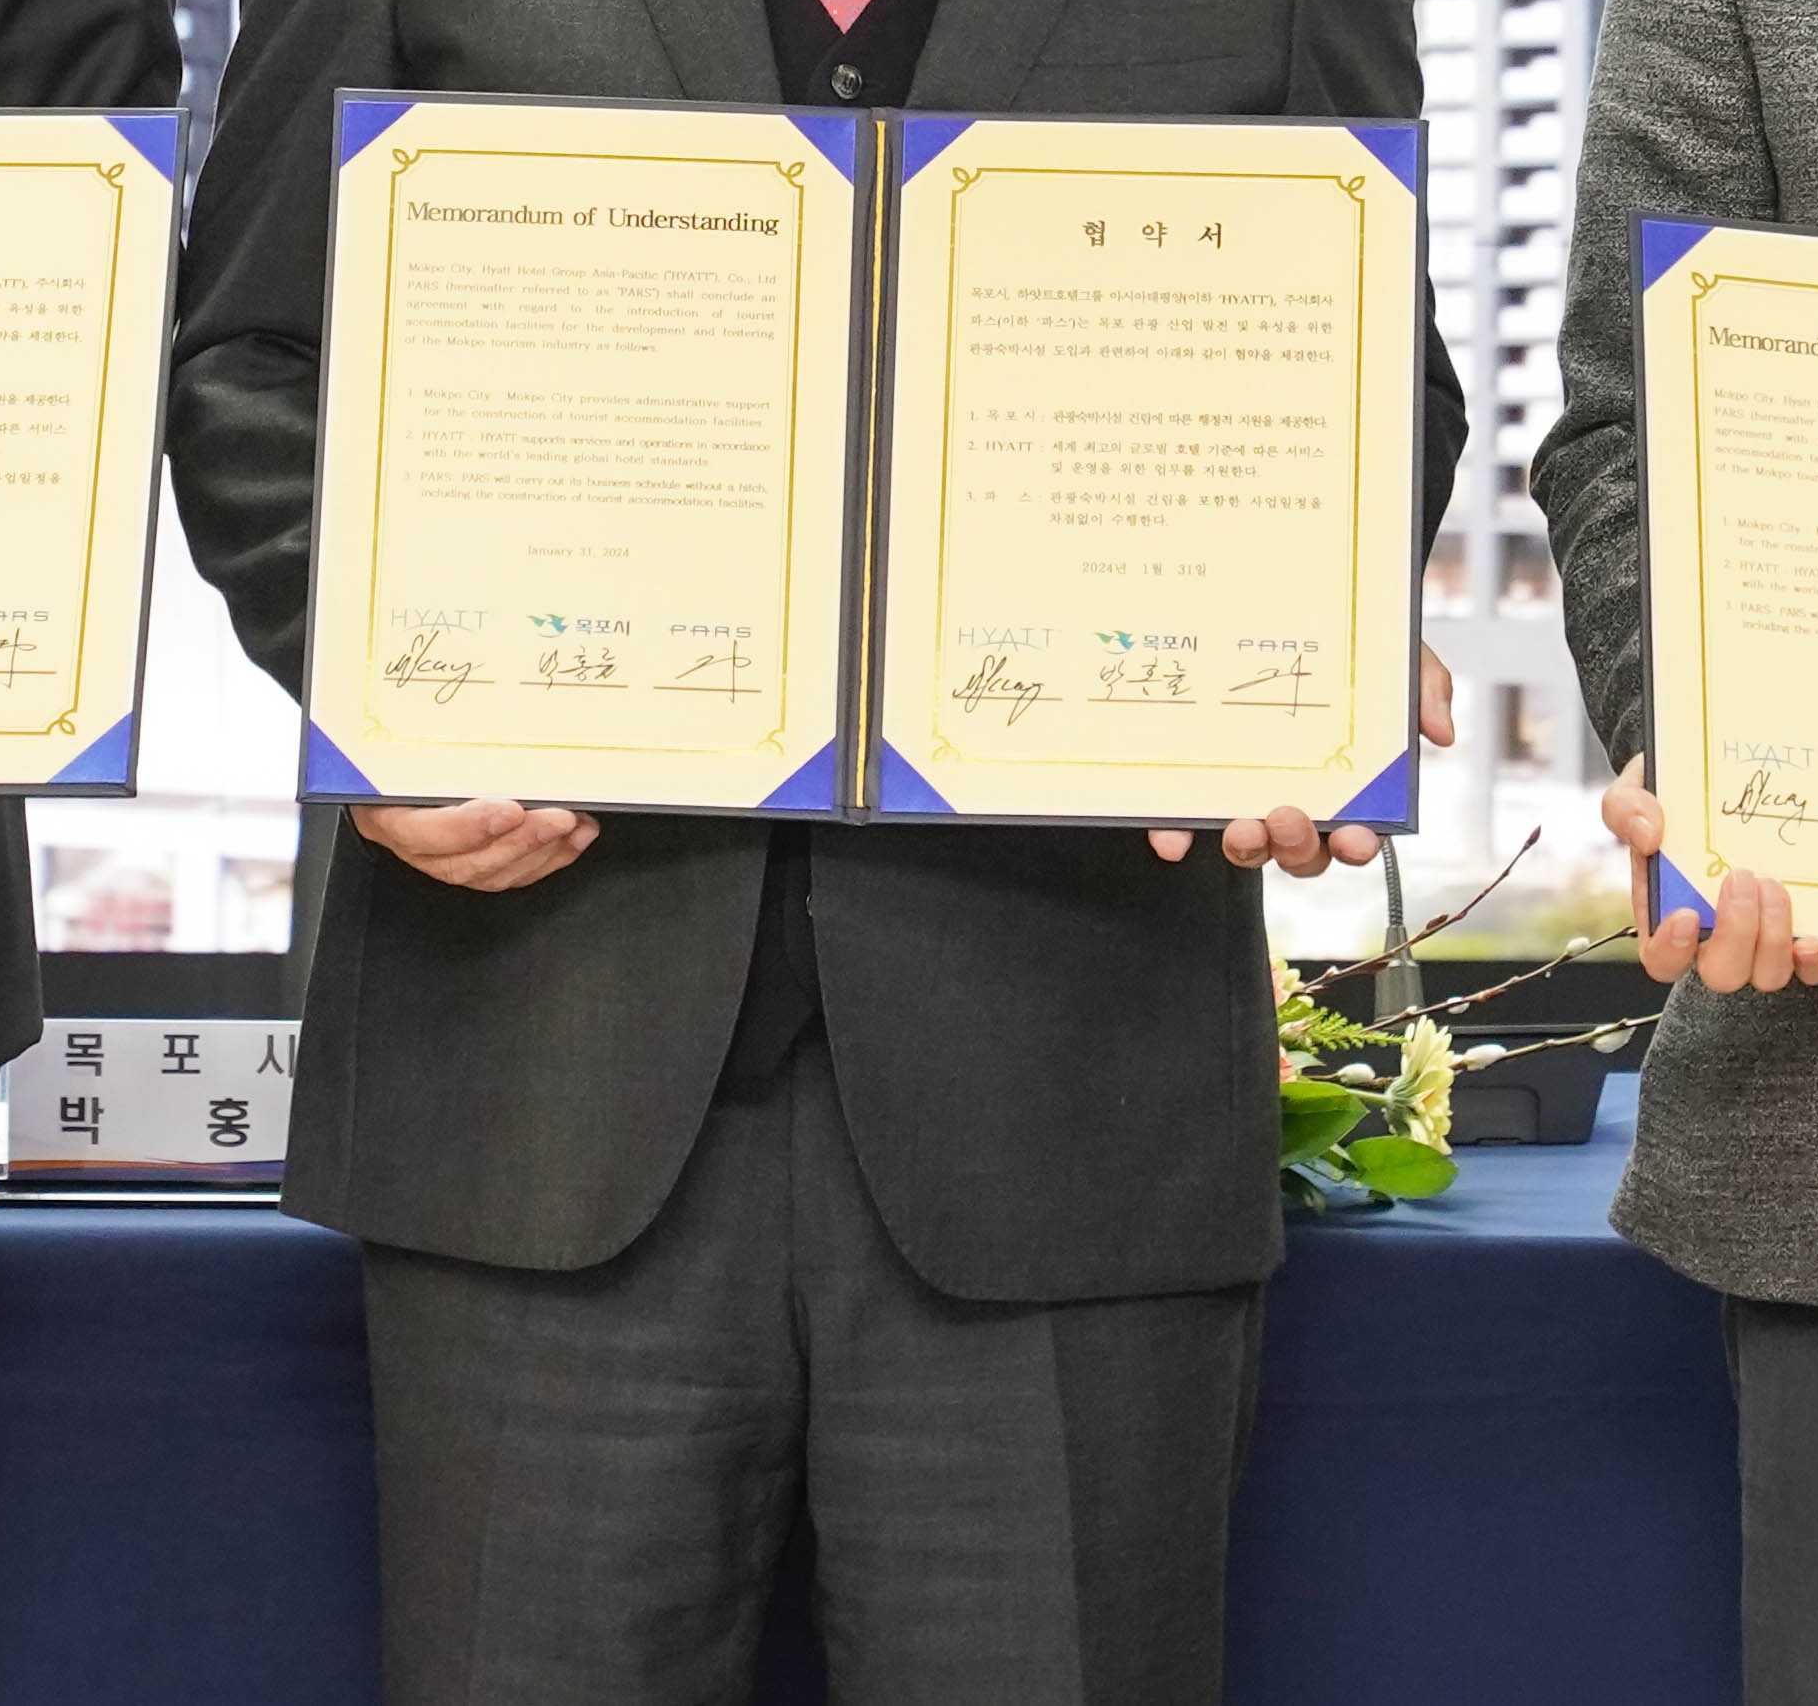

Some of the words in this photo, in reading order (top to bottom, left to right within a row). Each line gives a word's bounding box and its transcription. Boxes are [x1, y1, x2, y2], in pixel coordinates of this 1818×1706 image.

[406, 201, 564, 226] Memorandum
[572, 206, 598, 227] of
[608, 207, 781, 237] Understanding
[390, 606, 488, 634] HYATT
[575, 618, 631, 637] 목포시
[669, 624, 752, 639] PARS
[958, 625, 1055, 651] HYATT
[1142, 634, 1198, 653] 목포시
[1236, 638, 1319, 655] PARS
[1723, 739, 1815, 771] HYATT
[65, 1033, 104, 1076] 목
[161, 1034, 201, 1074] 포
[60, 1097, 104, 1144] 박
[207, 1098, 250, 1147] 홍
